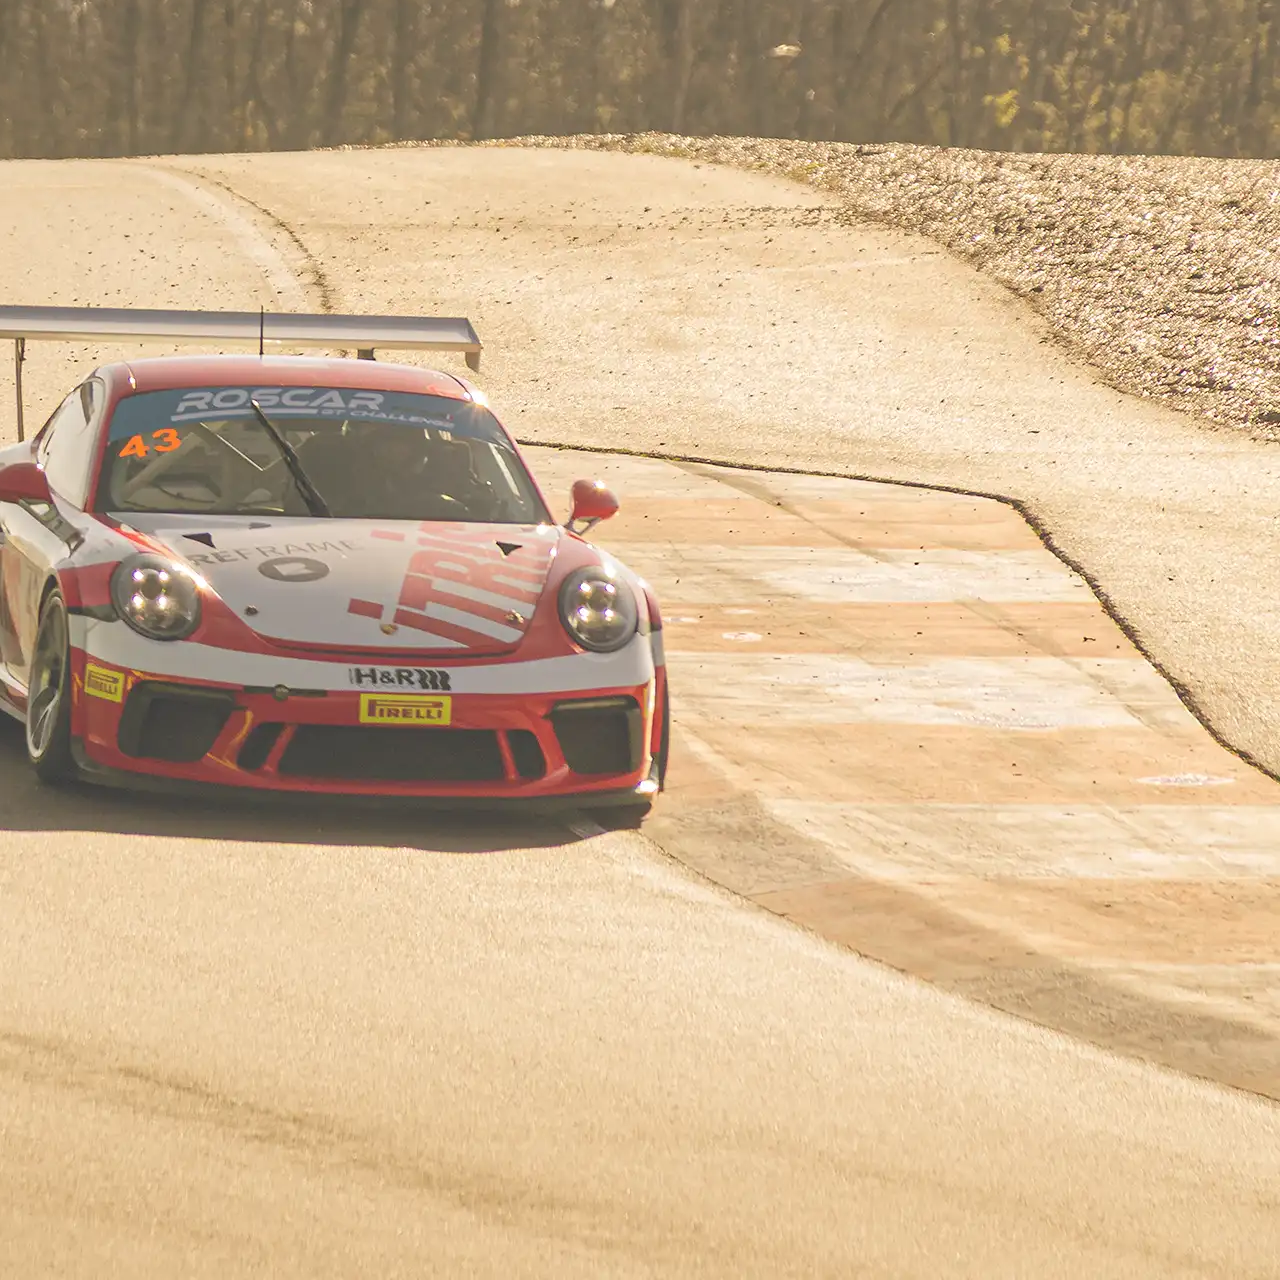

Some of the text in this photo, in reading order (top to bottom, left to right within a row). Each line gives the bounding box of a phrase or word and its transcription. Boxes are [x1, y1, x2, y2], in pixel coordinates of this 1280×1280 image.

[176, 388, 385, 412] ROSCAR
[118, 427, 183, 458] 43
[367, 698, 444, 719] PIRELLI
